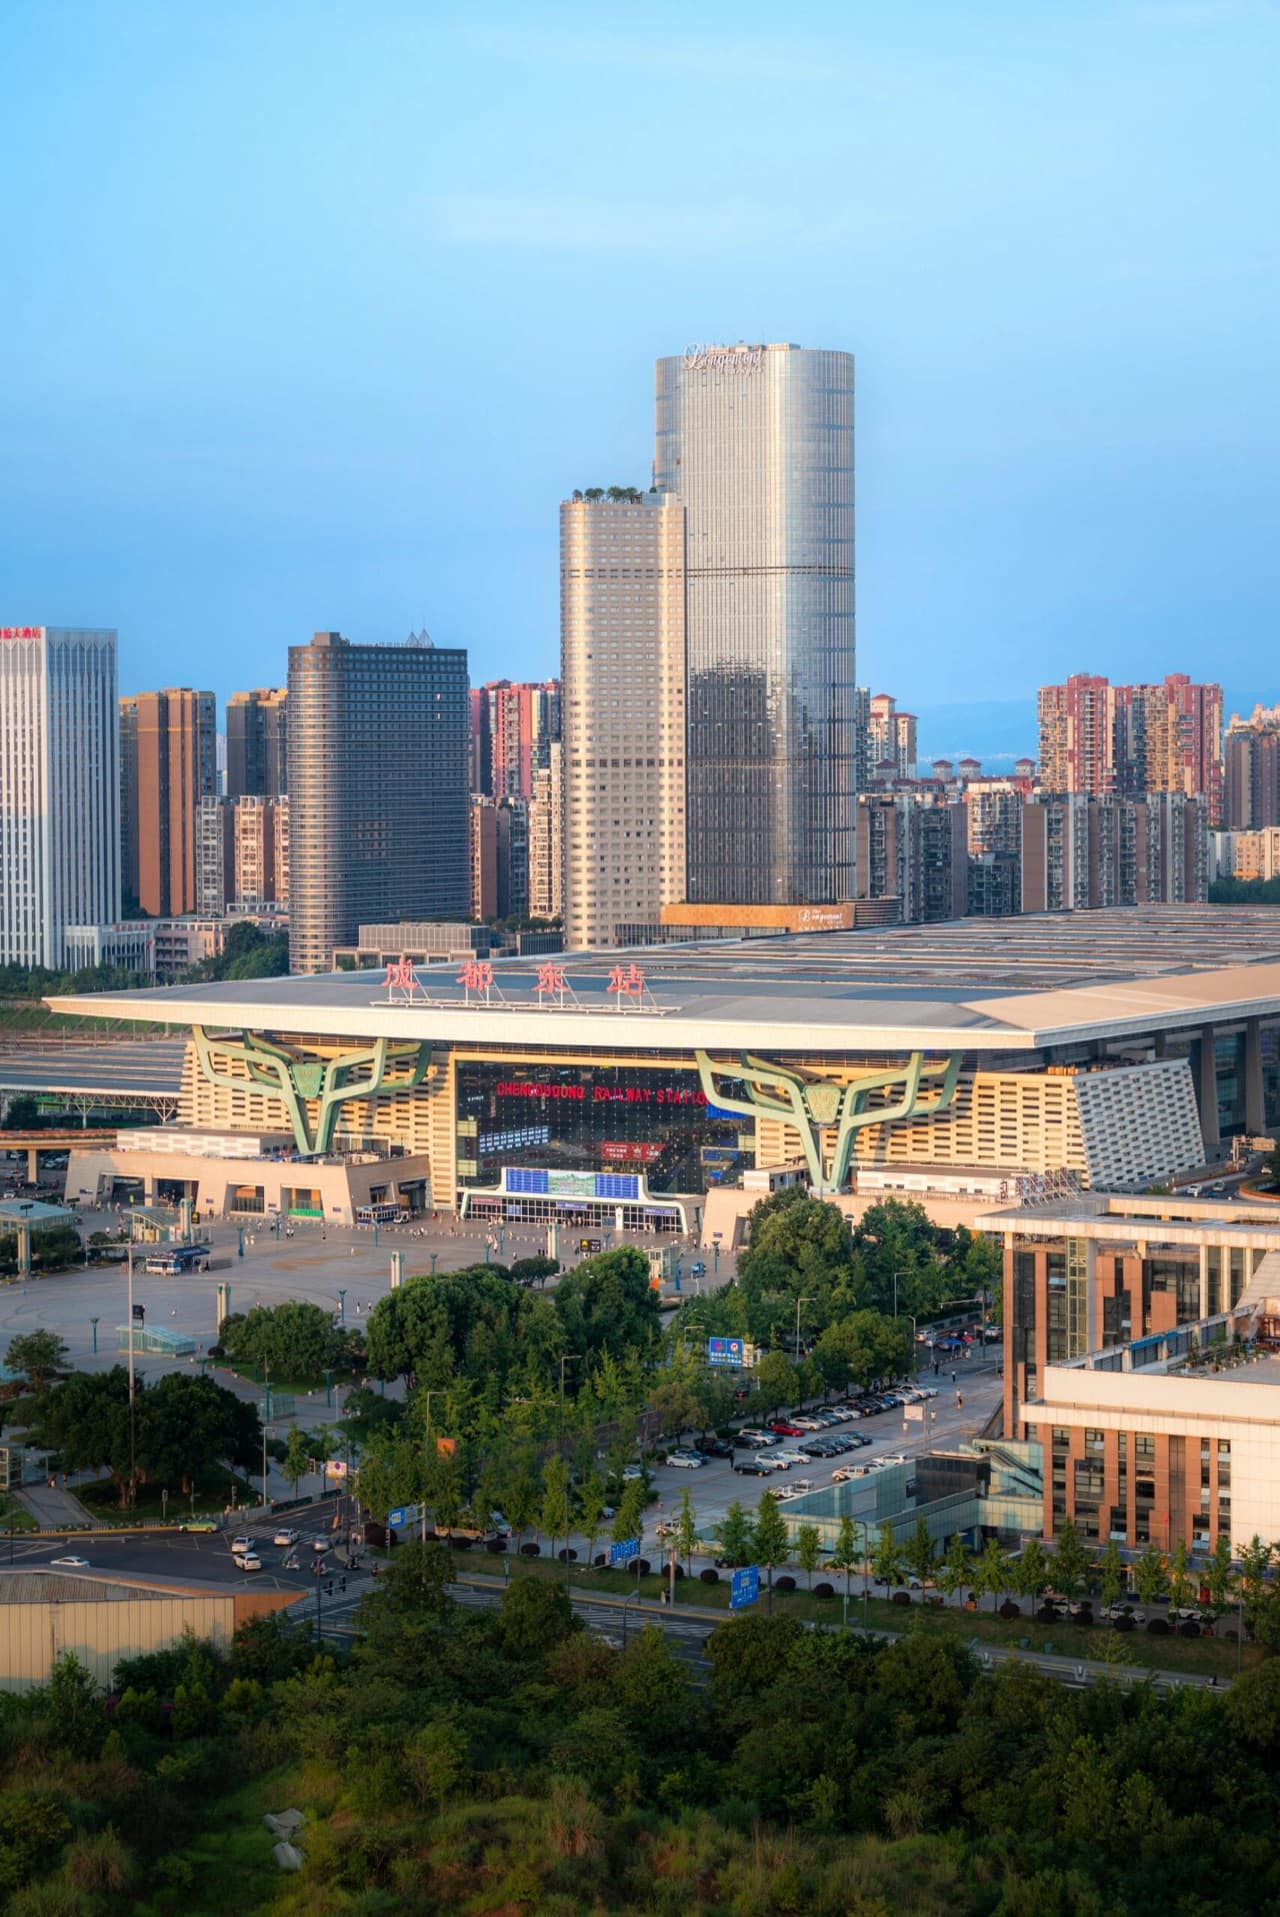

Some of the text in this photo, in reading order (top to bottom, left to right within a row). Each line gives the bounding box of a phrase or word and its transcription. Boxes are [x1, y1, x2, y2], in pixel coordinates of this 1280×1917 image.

[381, 957, 645, 996] 成都东站
[496, 1082, 585, 1100] CHENGDUDONG
[594, 1086, 652, 1103] RAILWAY
[656, 1088, 710, 1105] STATIO
